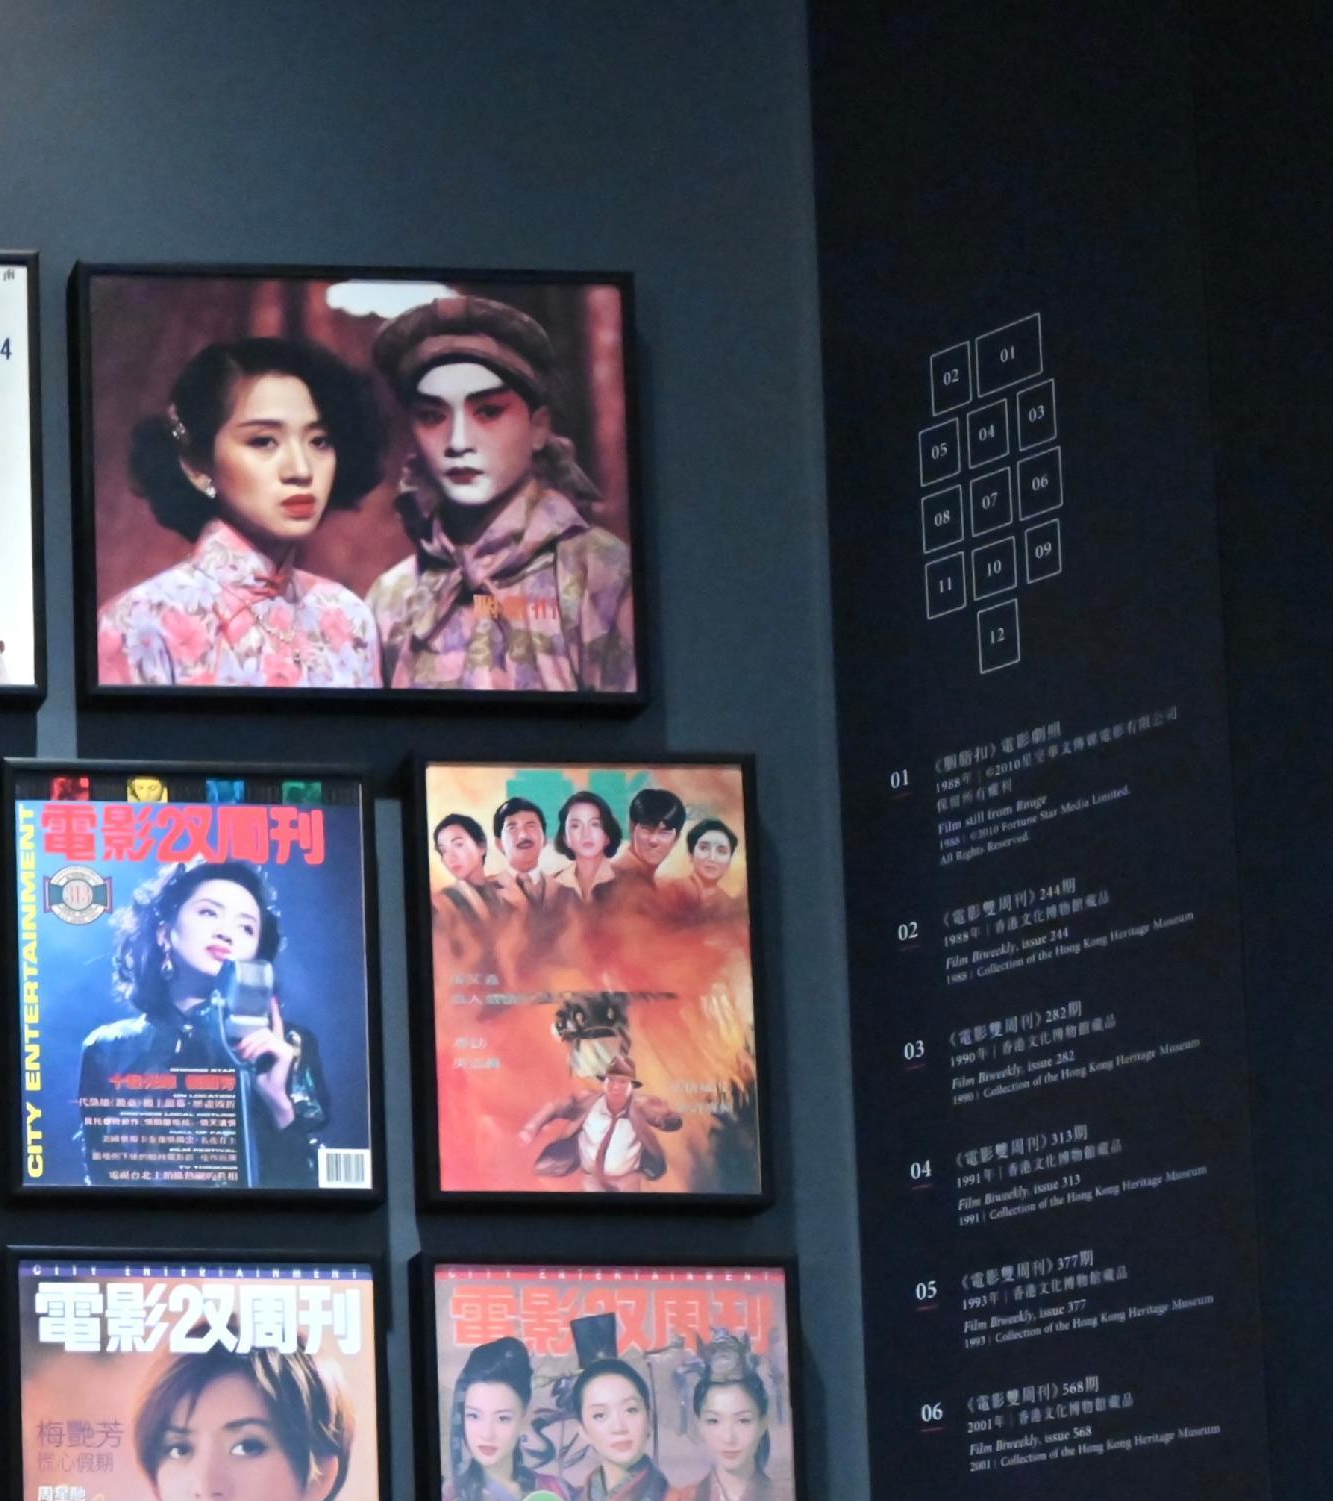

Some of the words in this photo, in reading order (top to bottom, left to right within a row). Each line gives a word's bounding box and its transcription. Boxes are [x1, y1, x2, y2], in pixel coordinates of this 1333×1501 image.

[943, 369, 959, 385] 02
[1000, 347, 1015, 361] 01
[931, 443, 948, 459] 05
[979, 425, 995, 441] 04
[1029, 406, 1045, 421] 03
[934, 510, 950, 525] 08
[982, 493, 998, 508] 07
[1032, 475, 1048, 490] 06
[939, 578, 953, 592] 11
[987, 560, 1001, 575] 10
[1035, 543, 1052, 558] 09
[990, 628, 1005, 643] 12
[890, 769, 909, 788] 01
[898, 922, 918, 941] 02
[18, 803, 41, 1091] ENTERTAINMENT
[904, 1040, 925, 1060] 03
[26, 1103, 43, 1178] CITY
[911, 1160, 931, 1179] 04
[33, 1266, 98, 1276] CITY
[125, 1267, 359, 1279] ENTERTAINMENT
[916, 1280, 937, 1300] 05
[922, 1403, 943, 1422] 06
[37, 1420, 125, 1448] 梅艷芳
